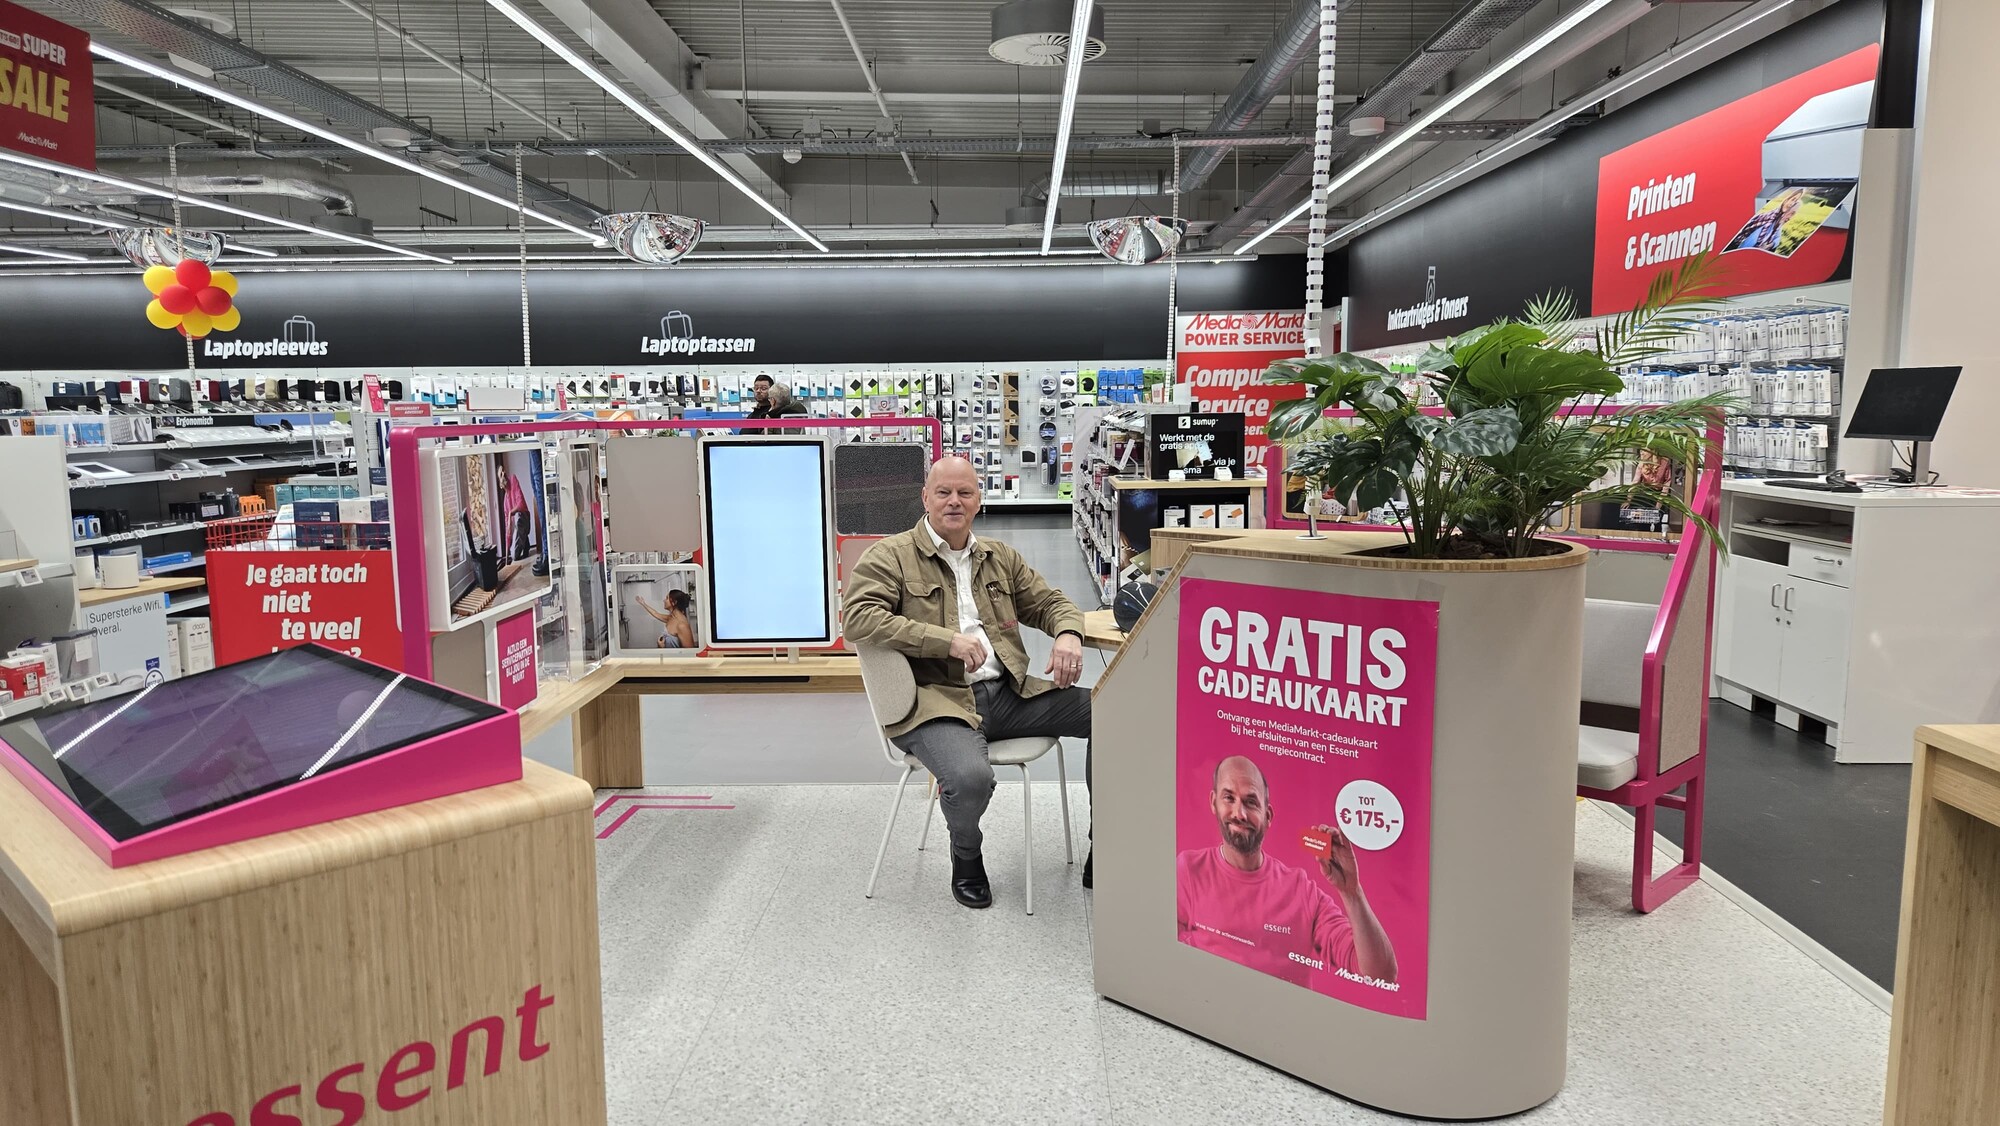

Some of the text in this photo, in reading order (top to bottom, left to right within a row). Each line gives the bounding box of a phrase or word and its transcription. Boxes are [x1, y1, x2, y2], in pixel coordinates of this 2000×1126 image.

[23, 33, 66, 66] SUPER
[0, 57, 70, 123] SALE
[1627, 172, 1696, 221] Printen
[1624, 221, 1717, 270] & Scannen
[1186, 312, 1305, 330] Media Markt
[1387, 296, 1468, 331] Inktcartridges & Toners
[204, 339, 328, 360] Laptopsleeves
[641, 336, 756, 356] Laptoptassen
[1185, 331, 1305, 346] POWER SERVICE
[1185, 366, 1295, 391] Compu
[1190, 394, 1270, 417] ervice
[176, 416, 214, 428] Ergonomisch
[1160, 434, 1184, 442] Werkt
[1204, 432, 1215, 441] de
[1160, 442, 1182, 452] gratis
[1214, 457, 1236, 467] via je
[246, 563, 368, 587] Je gaat toch
[89, 600, 162, 624] Supersterke Wifi.
[262, 590, 312, 613] niet
[91, 622, 122, 637] Overal.
[282, 616, 361, 640] te veel
[502, 644, 532, 669] SERVICEPARTNER
[507, 642, 519, 656] ALTIJD
[1200, 606, 1406, 690] GRATIS
[1198, 666, 1407, 727] CADEAUKAART
[1217, 710, 1378, 750] Ontvang een MediaMarkt-cadeaukaart
[1231, 724, 1358, 758] bij het afsluiten van een Essent
[1259, 742, 1326, 764] energiecontract.
[1358, 796, 1375, 806] TOT
[1340, 808, 1399, 832] € 175,-
[1264, 923, 1291, 934] essent
[1288, 951, 1323, 970] essent
[1335, 967, 1400, 992] Media Markt
[185, 984, 555, 1126] ssent
